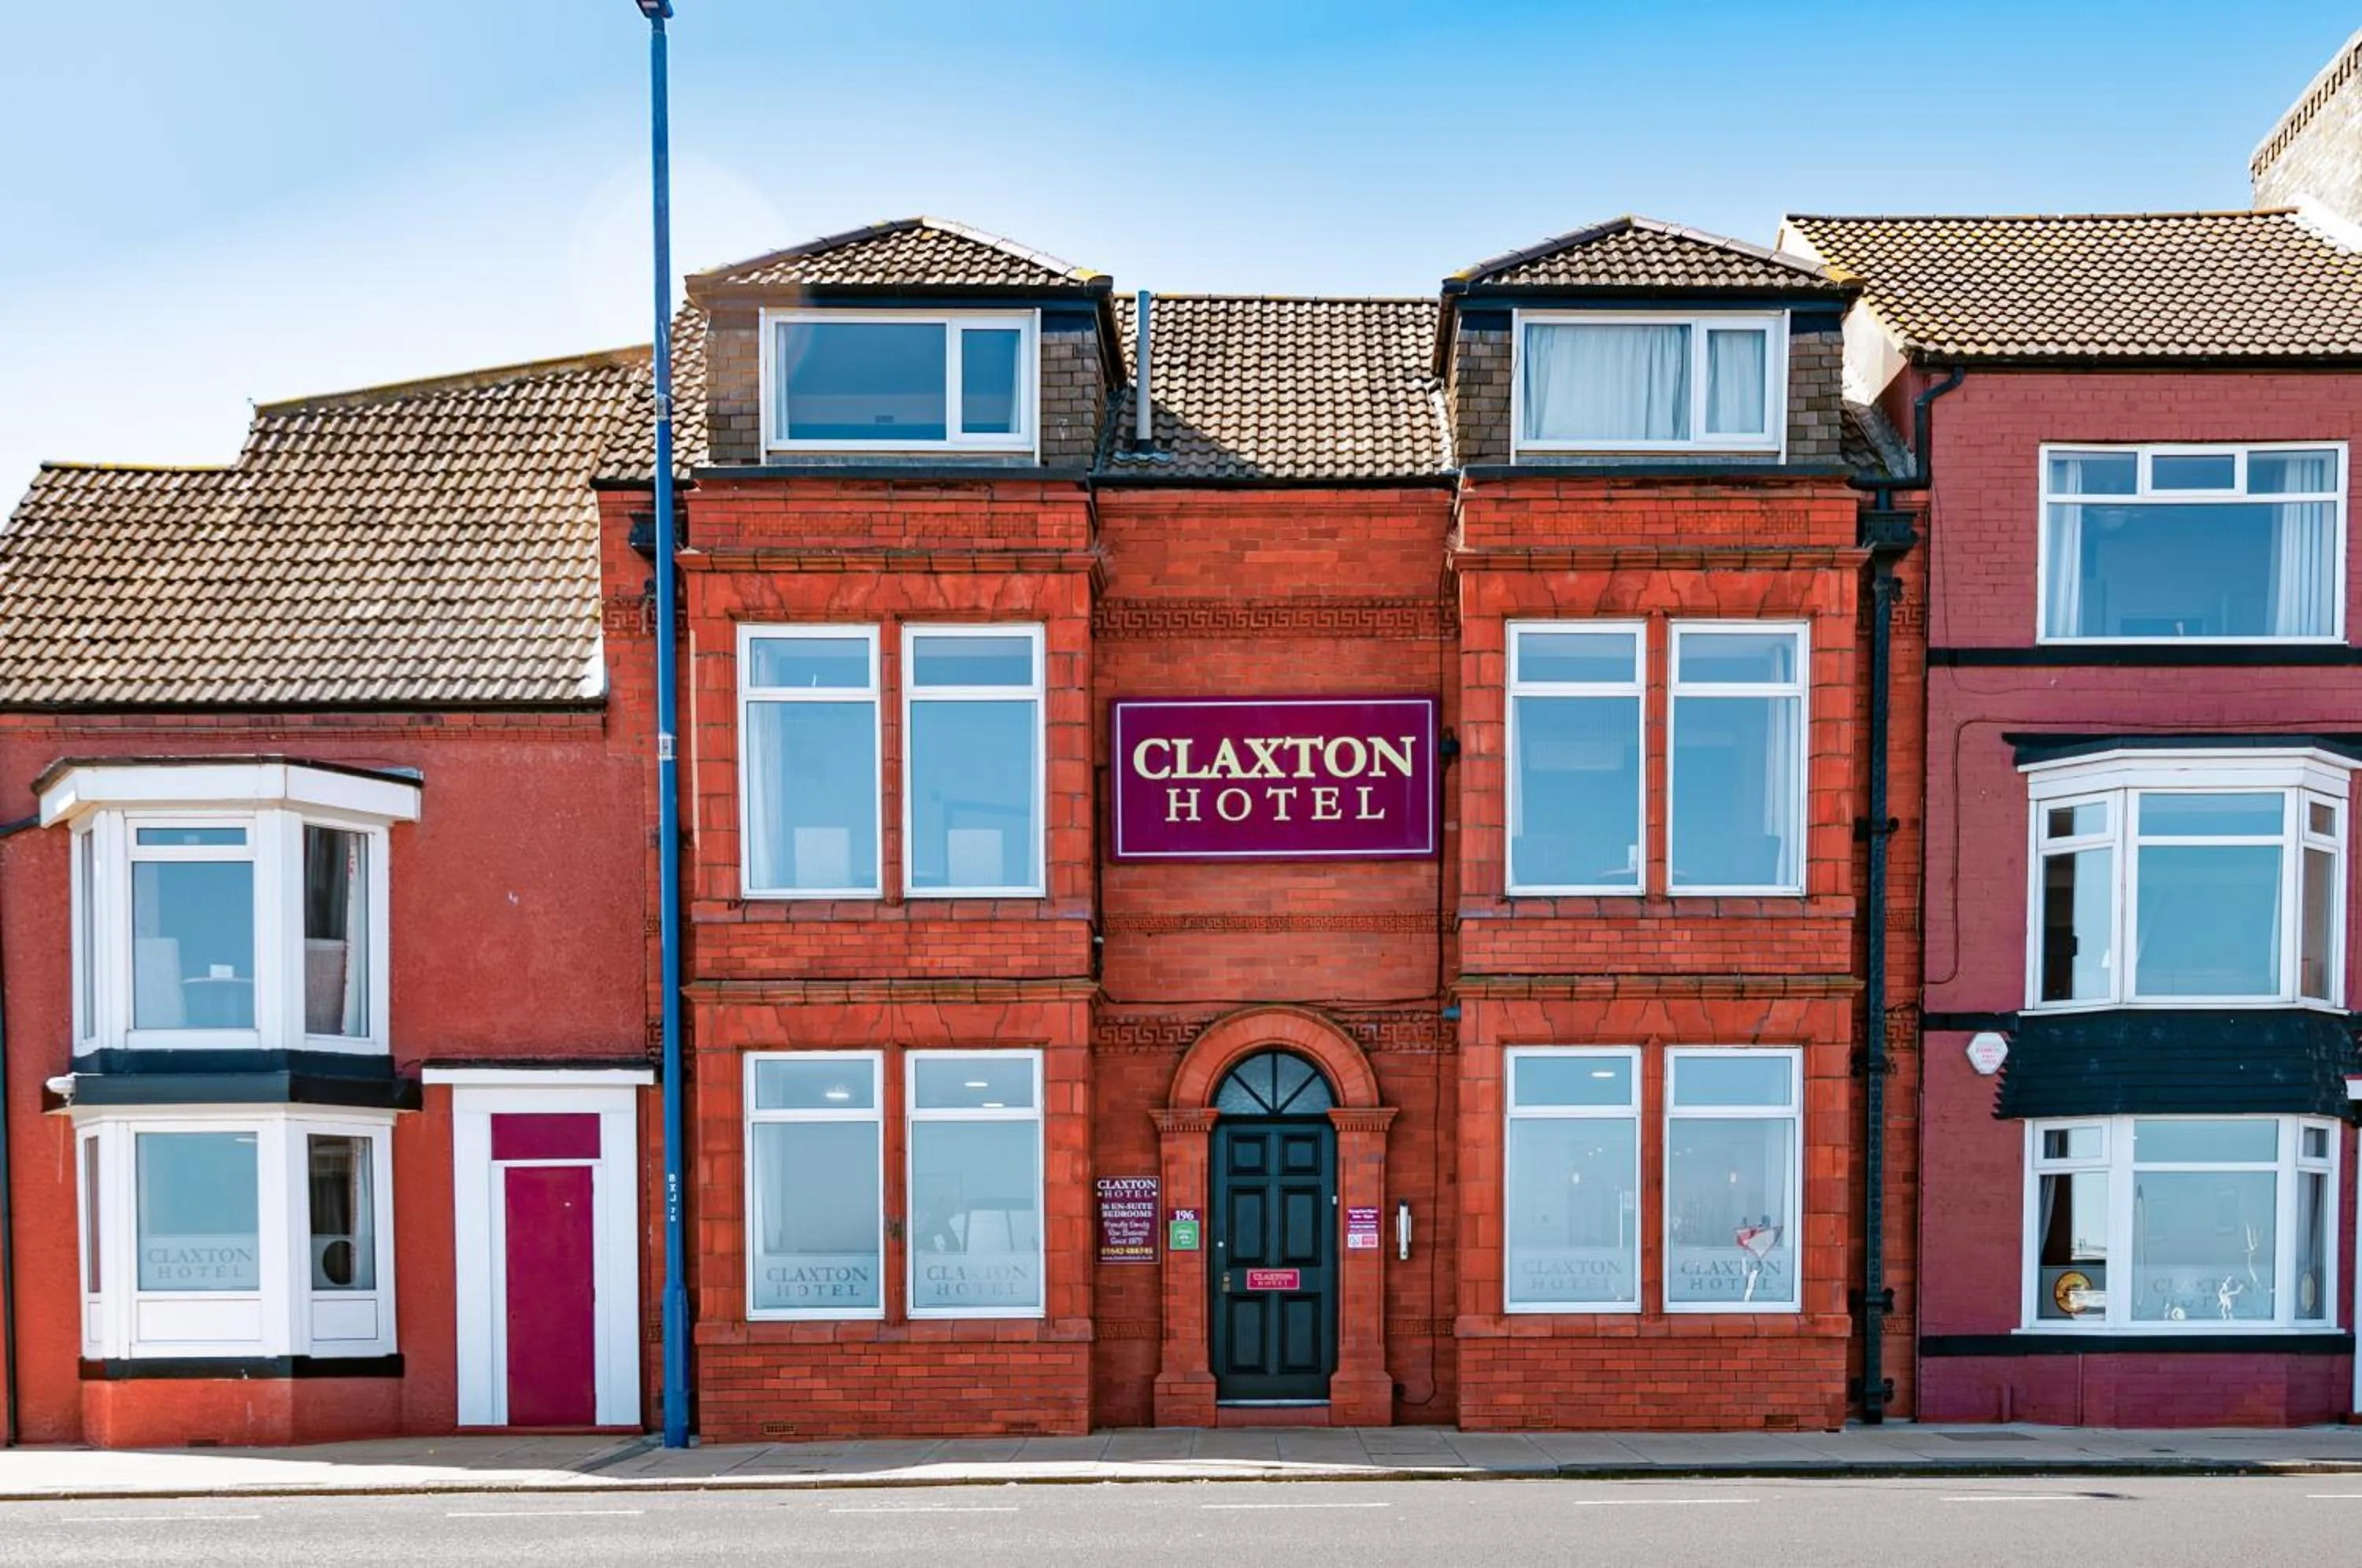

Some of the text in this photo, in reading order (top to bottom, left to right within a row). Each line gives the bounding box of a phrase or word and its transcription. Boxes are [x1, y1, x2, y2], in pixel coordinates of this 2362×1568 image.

[1133, 735, 1416, 779] CLAXTON
[1164, 786, 1386, 822] HOTEL
[1097, 1179, 1157, 1190] CLAXTON
[1104, 1189, 1151, 1198] HOTEL
[1175, 1209, 1194, 1221] 196
[147, 1246, 253, 1263] CLAXTON
[157, 1265, 246, 1279] HOTEL
[767, 1267, 869, 1282] CLAXTON
[776, 1284, 861, 1298] HOTEL
